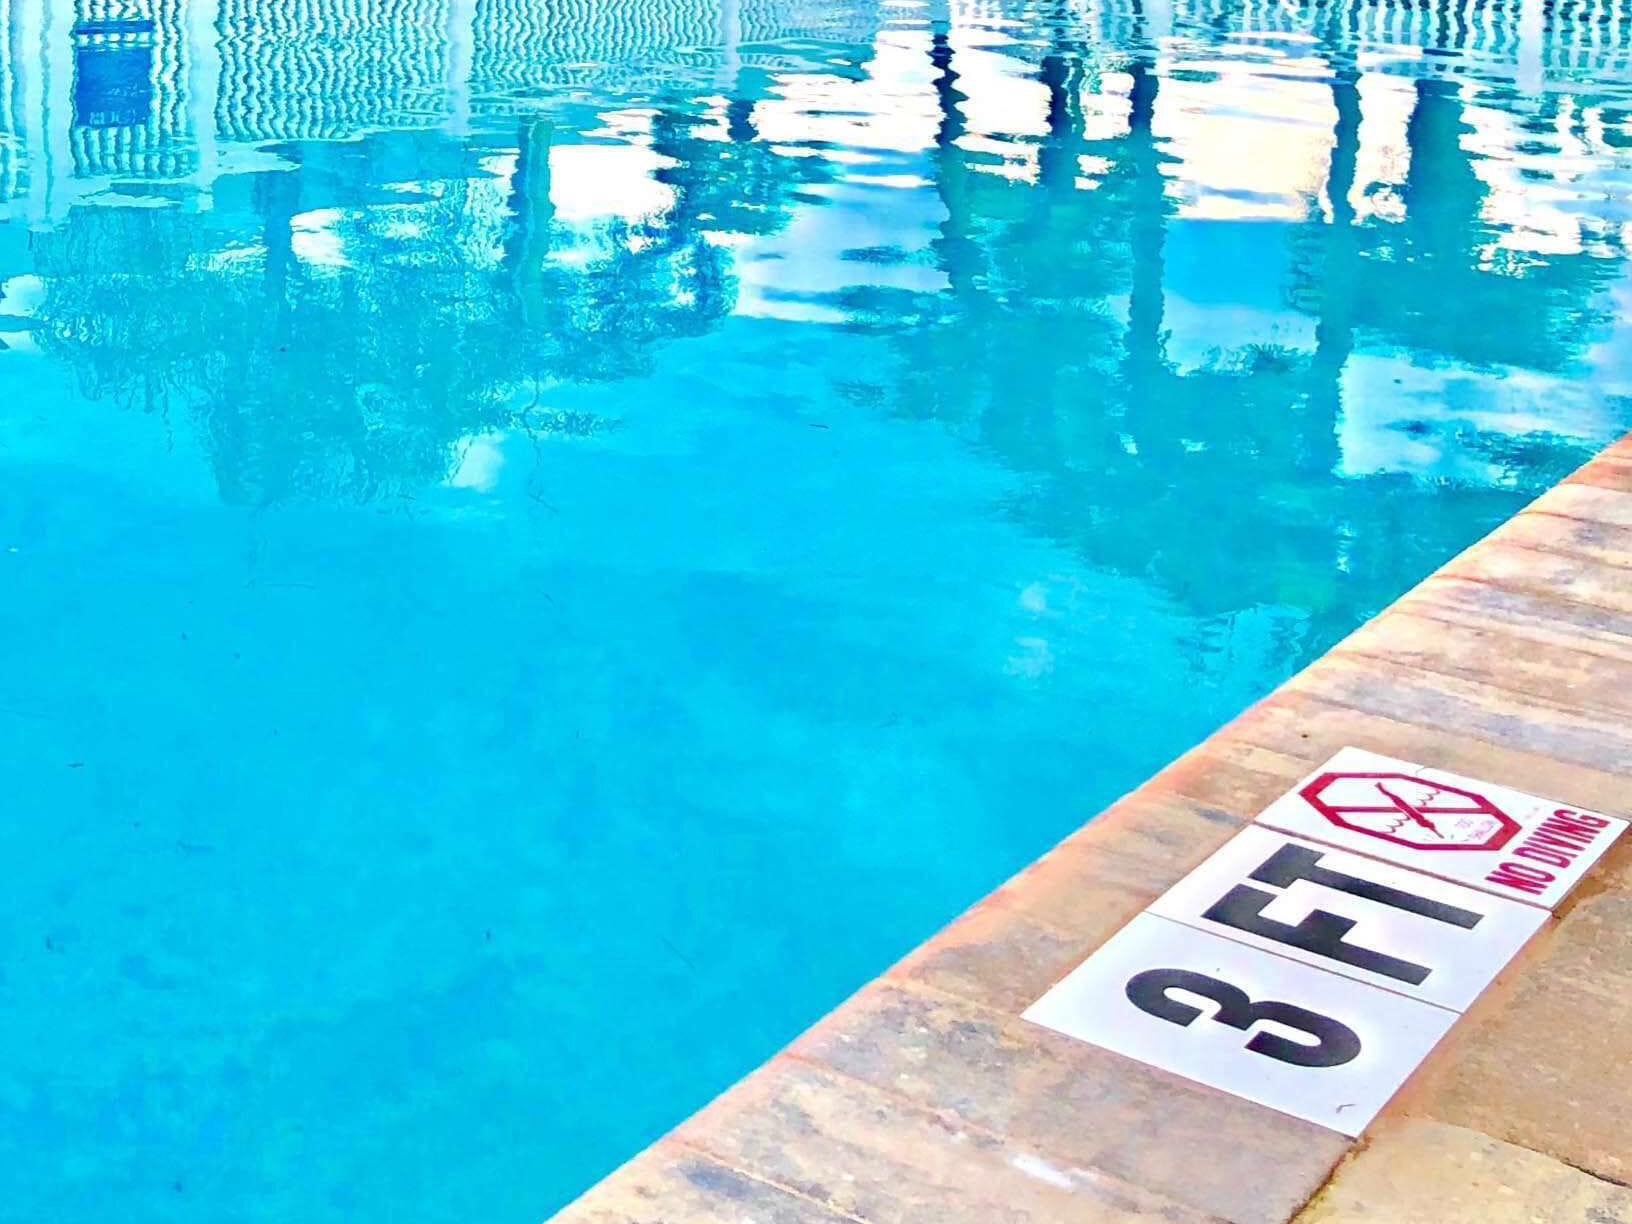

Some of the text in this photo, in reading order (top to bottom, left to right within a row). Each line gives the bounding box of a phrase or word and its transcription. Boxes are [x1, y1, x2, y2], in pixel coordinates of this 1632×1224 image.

[1511, 808, 1612, 869] DIVING
[1484, 862, 1556, 896] NO
[1125, 842, 1485, 1069] 3 FT
